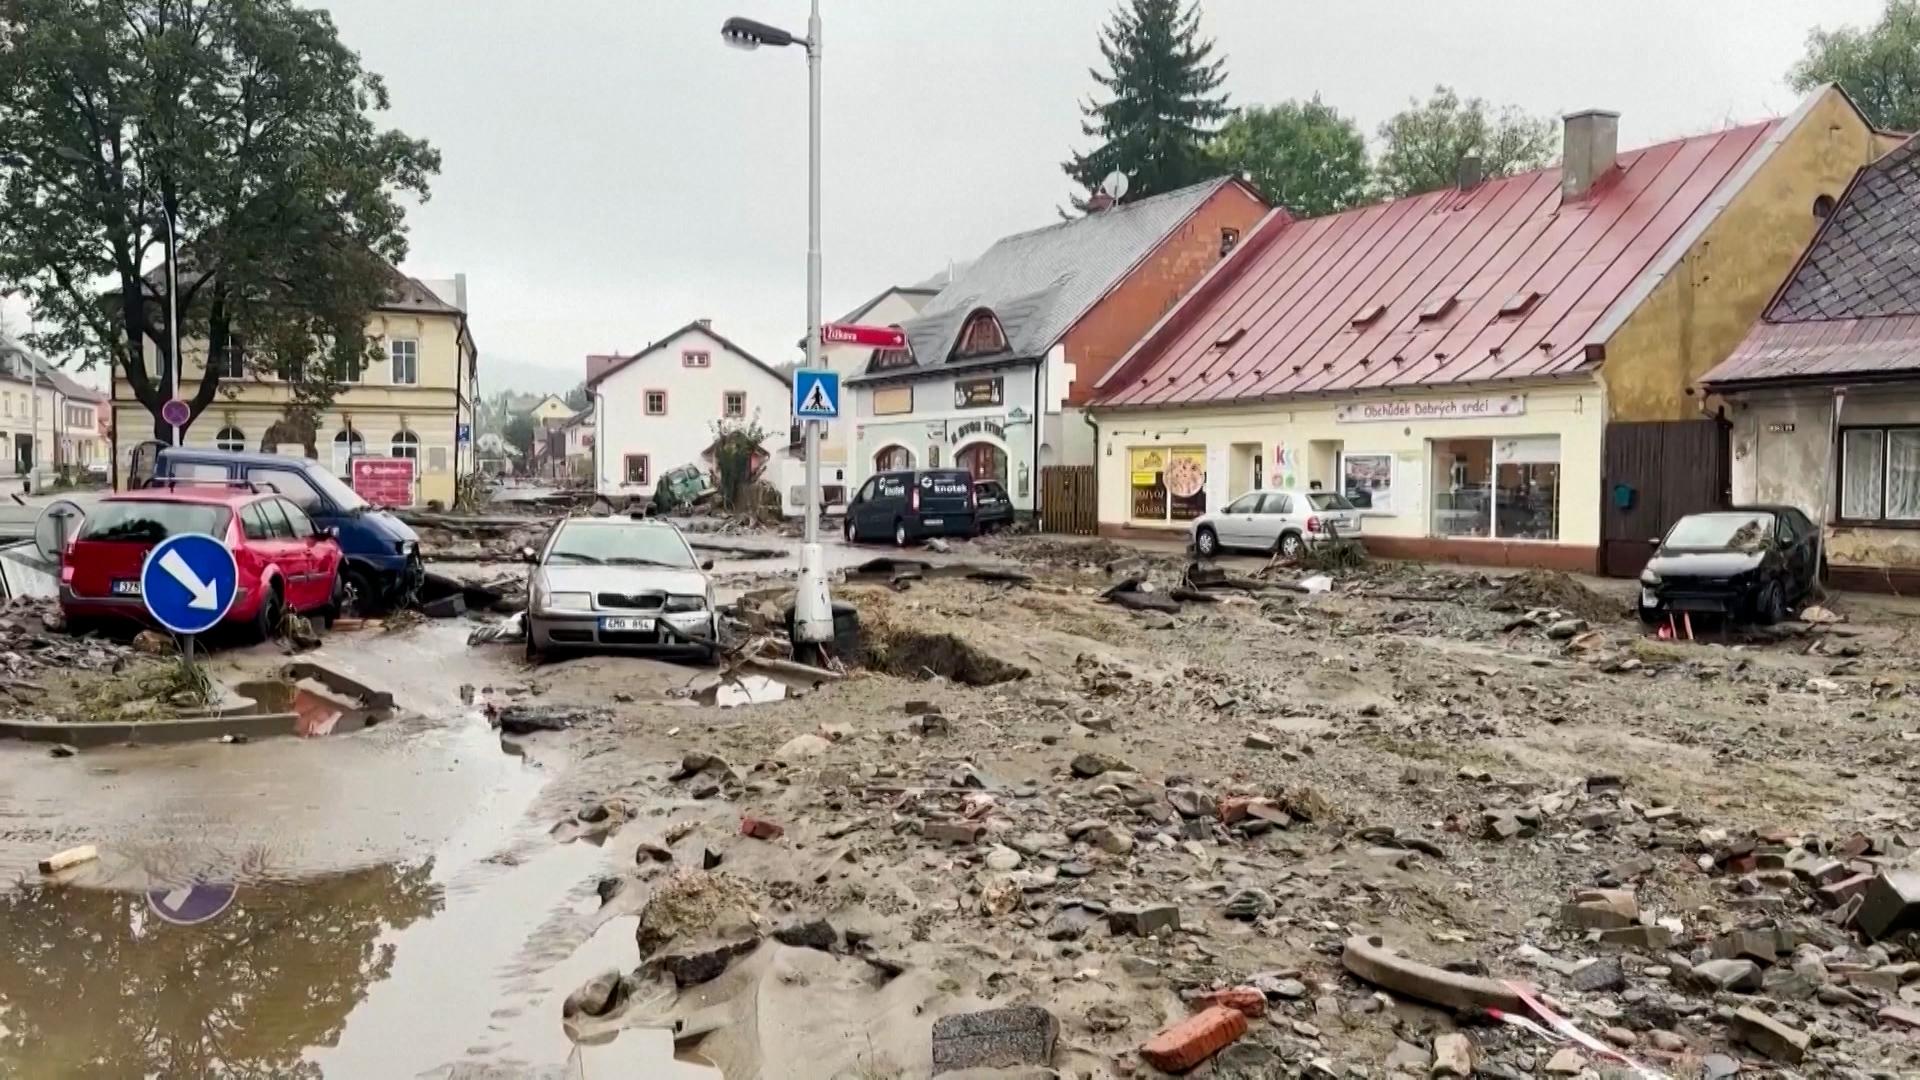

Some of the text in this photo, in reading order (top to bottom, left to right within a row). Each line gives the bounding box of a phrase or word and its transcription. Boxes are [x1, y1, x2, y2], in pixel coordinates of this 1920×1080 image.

[1364, 399, 1489, 418] Obchůdek Dobrých srdcí
